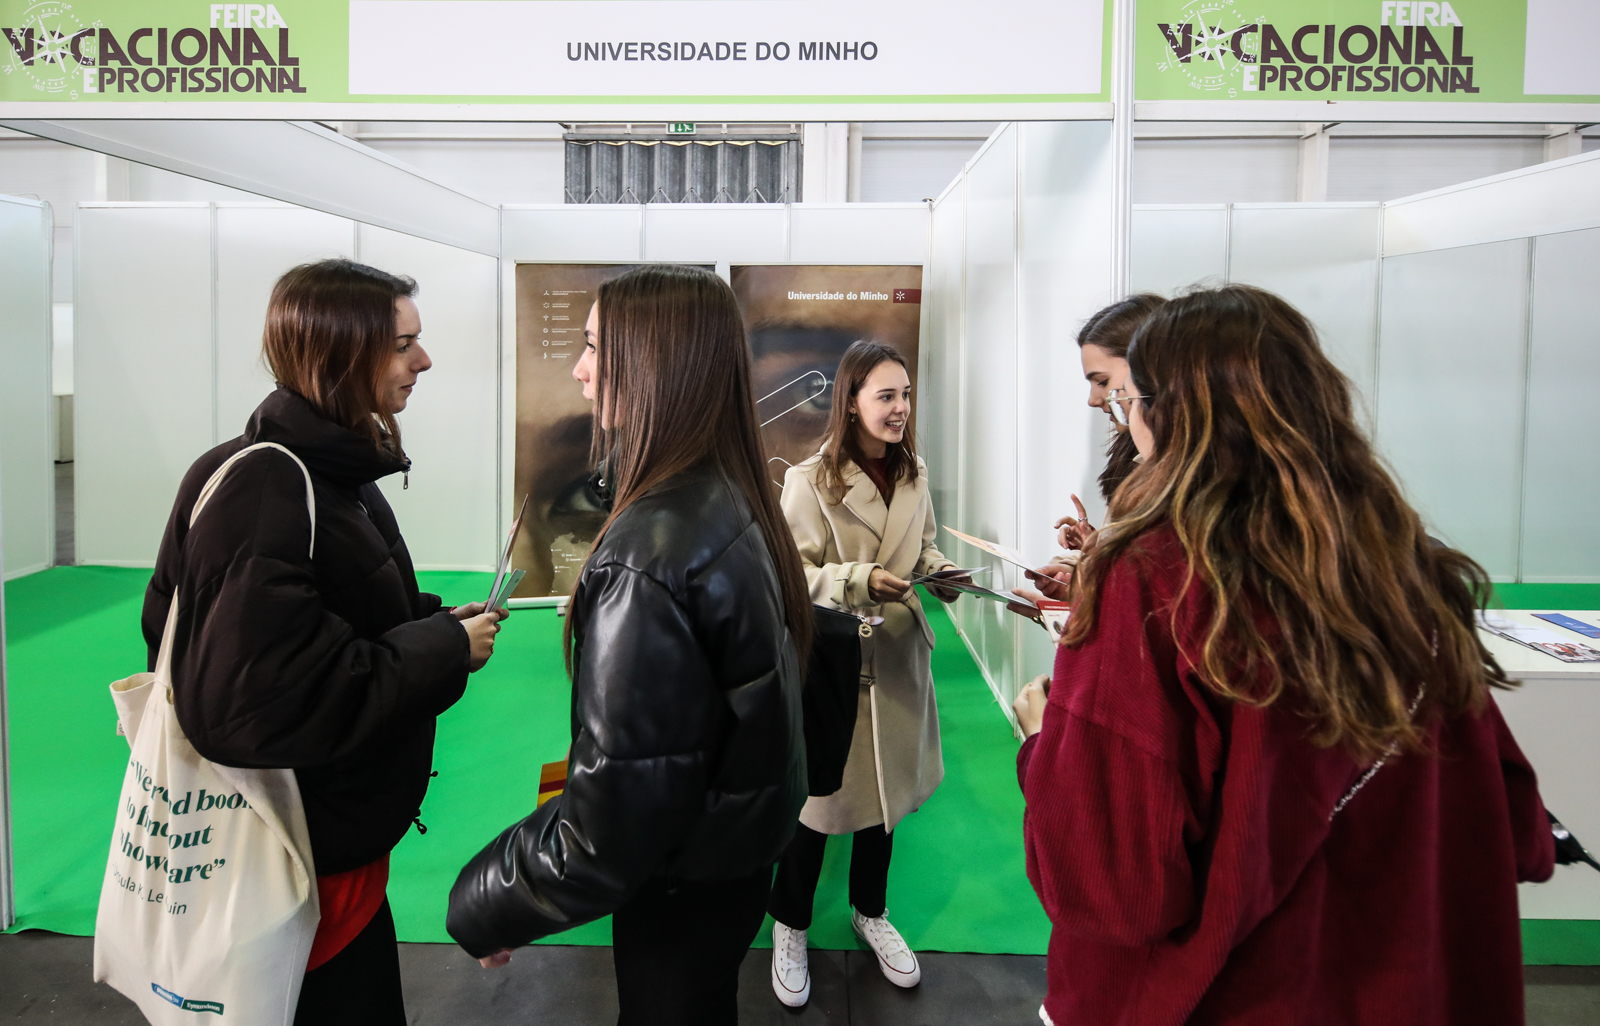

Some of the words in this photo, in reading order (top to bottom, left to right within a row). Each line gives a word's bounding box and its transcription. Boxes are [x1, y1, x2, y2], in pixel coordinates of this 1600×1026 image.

[210, 4, 288, 28] FEIRA
[1381, 1, 1463, 27] FEIRA
[566, 42, 747, 61] UNIVERSIDADE
[755, 42, 790, 61] DO
[798, 41, 878, 61] MINHO
[787, 290, 845, 301] Universidade
[846, 291, 858, 301] do
[860, 291, 889, 301] Minho
[150, 784, 192, 816] rd
[168, 824, 214, 850] out
[147, 888, 164, 904] Le
